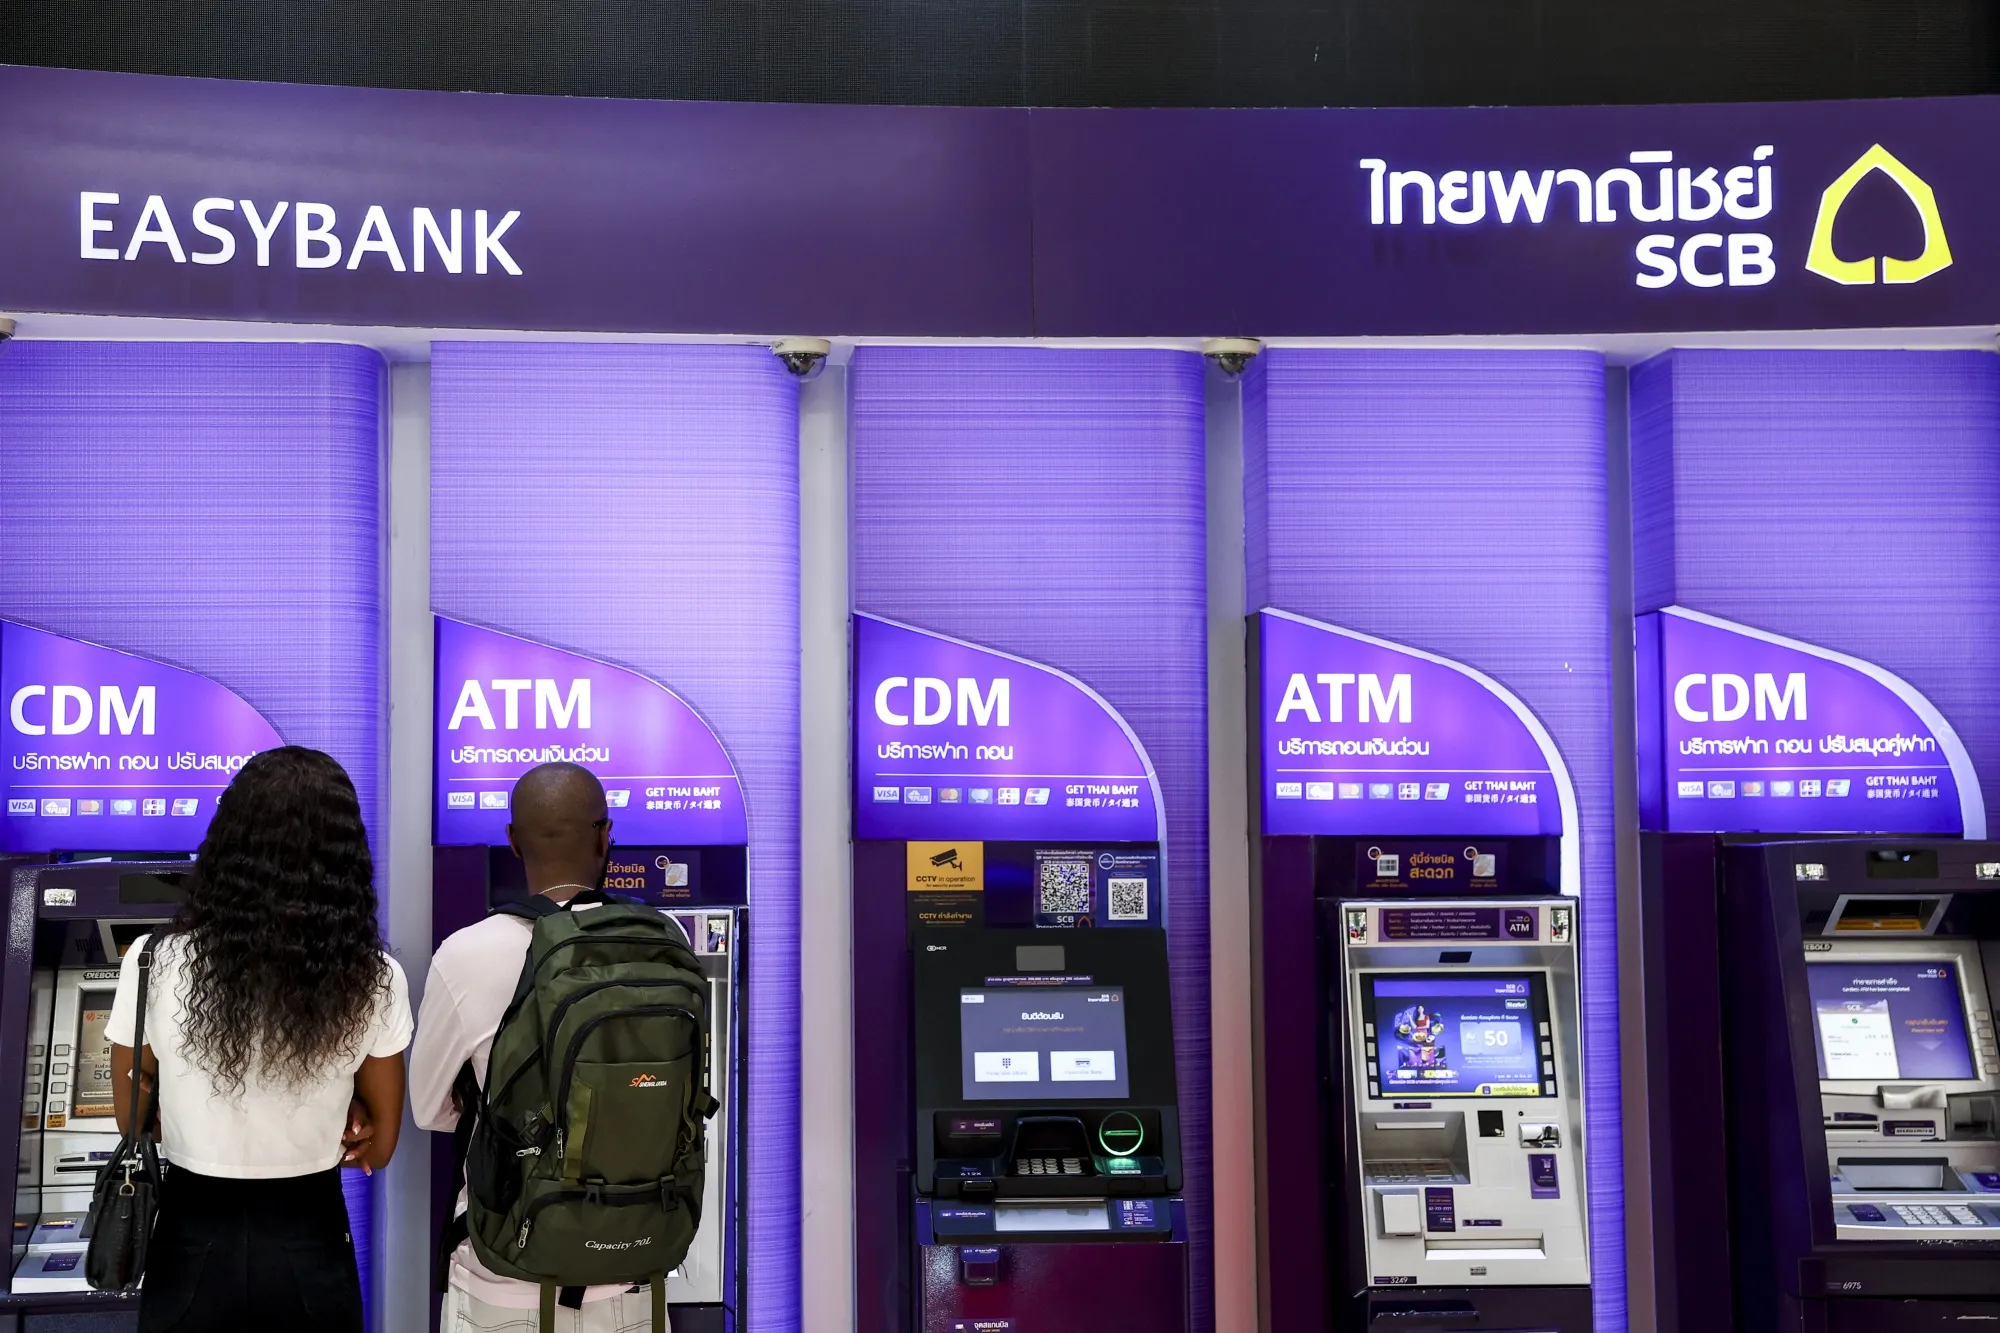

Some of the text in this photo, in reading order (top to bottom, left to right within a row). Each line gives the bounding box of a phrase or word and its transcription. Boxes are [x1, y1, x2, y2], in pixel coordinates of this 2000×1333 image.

[1360, 145, 1774, 225] ไทยพาณิชย์
[80, 191, 523, 276] EASYBANK
[1635, 233, 1776, 289] SCB
[447, 678, 592, 730] ATM
[874, 676, 1010, 727] CDM
[1275, 673, 1412, 723] ATM
[1673, 672, 1807, 723] CDM
[10, 684, 156, 736] CDM
[877, 741, 1014, 760] บริการฝาก ถอน
[1278, 736, 1430, 756] บริการถอนเงินด่วน
[1679, 733, 1935, 757] บริการฝาก ถอน ปรับสมุดคู่ฝาก
[13, 752, 110, 770] บริการฝาก
[119, 754, 158, 770] ถอน
[451, 743, 609, 764] บริการถอนเงินด่วน
[1464, 780, 1536, 791] GET THAI BAHT
[1866, 776, 1938, 786] GET THAI BAHT
[645, 786, 721, 797] GET THAI BAHT
[876, 789, 898, 798] VISA
[1065, 785, 1138, 795] GET THAI BAHT
[1279, 786, 1300, 794] VISA
[11, 801, 34, 810] VISA
[451, 794, 473, 803] VISA
[915, 875, 937, 883] CCTV
[1409, 867, 1454, 879] สะดวก
[1509, 923, 1530, 932] ATM
[1484, 1030, 1508, 1047] 50
[585, 1236, 652, 1250] Capacity 70L
[1390, 1276, 1408, 1284] 3249
[1842, 1281, 1862, 1290] 6975
